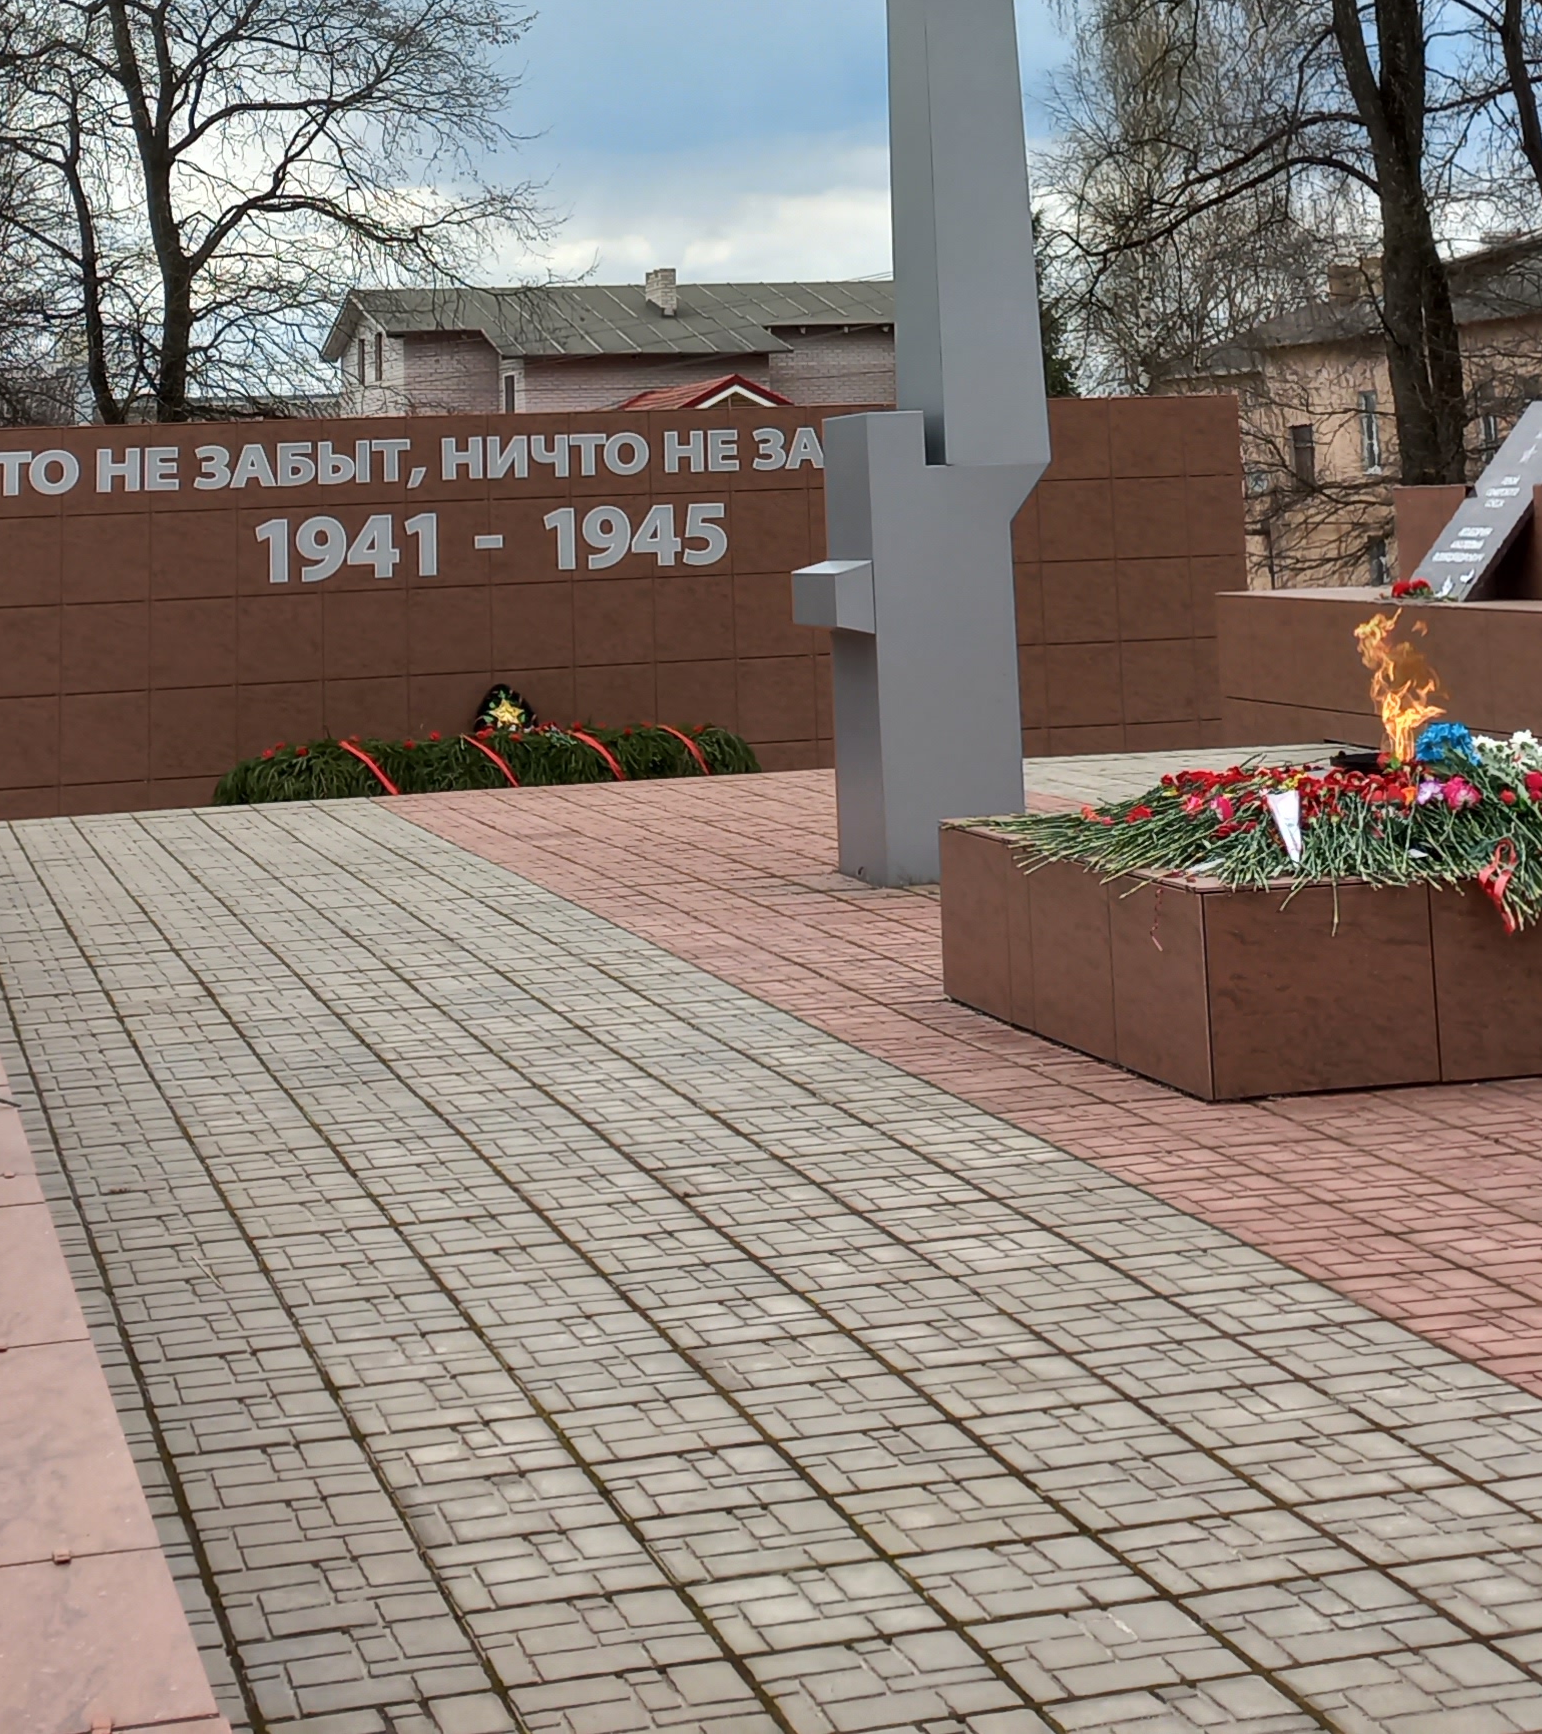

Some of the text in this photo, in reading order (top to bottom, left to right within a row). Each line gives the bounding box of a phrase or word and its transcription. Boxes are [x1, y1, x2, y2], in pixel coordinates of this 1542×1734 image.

[96, 446, 180, 493] НЕ
[193, 438, 427, 489] ЗАБЫТ,
[440, 431, 650, 481] НИЧТО
[664, 428, 740, 473] НЕ
[255, 502, 728, 583] 1941 - 1945
